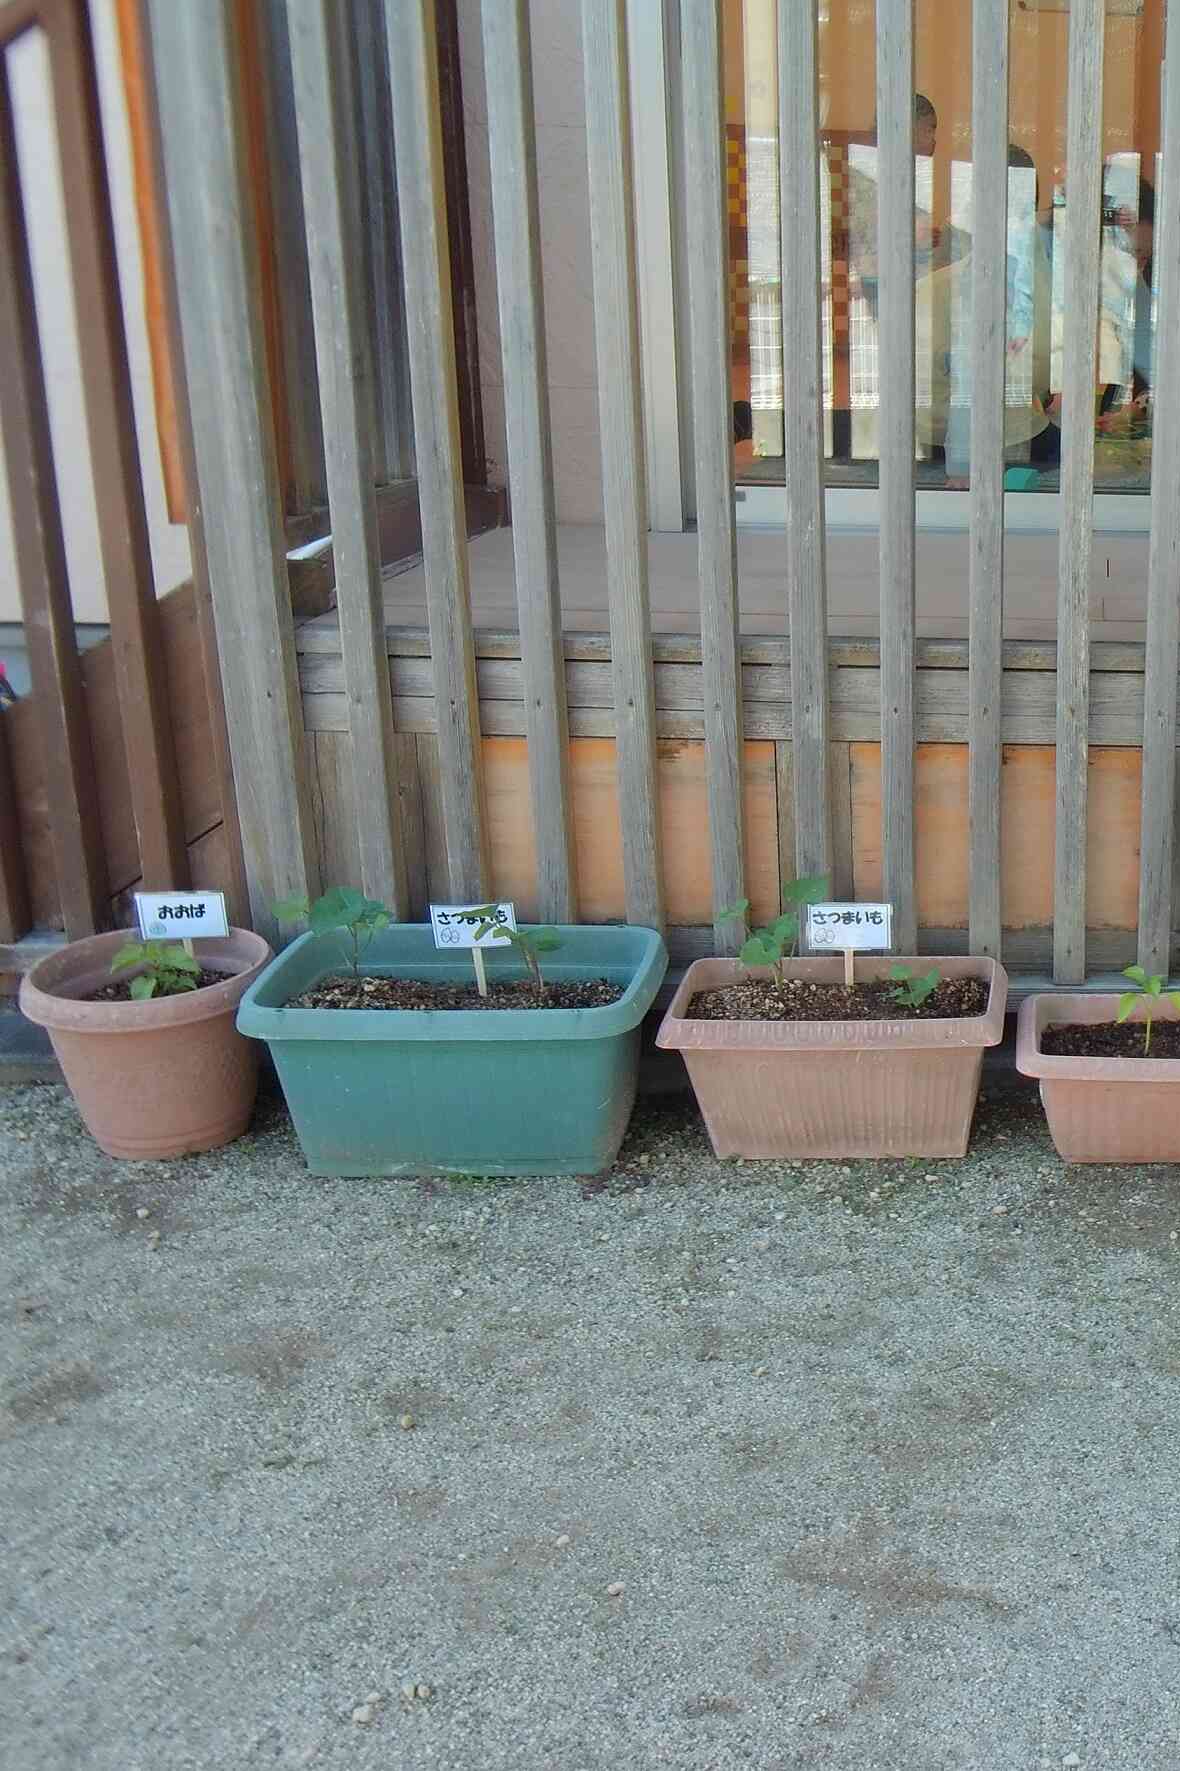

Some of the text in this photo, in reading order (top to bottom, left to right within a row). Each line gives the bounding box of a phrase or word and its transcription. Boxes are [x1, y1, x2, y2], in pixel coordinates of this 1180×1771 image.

[158, 903, 206, 919] おおば
[812, 910, 883, 925] さつまいも
